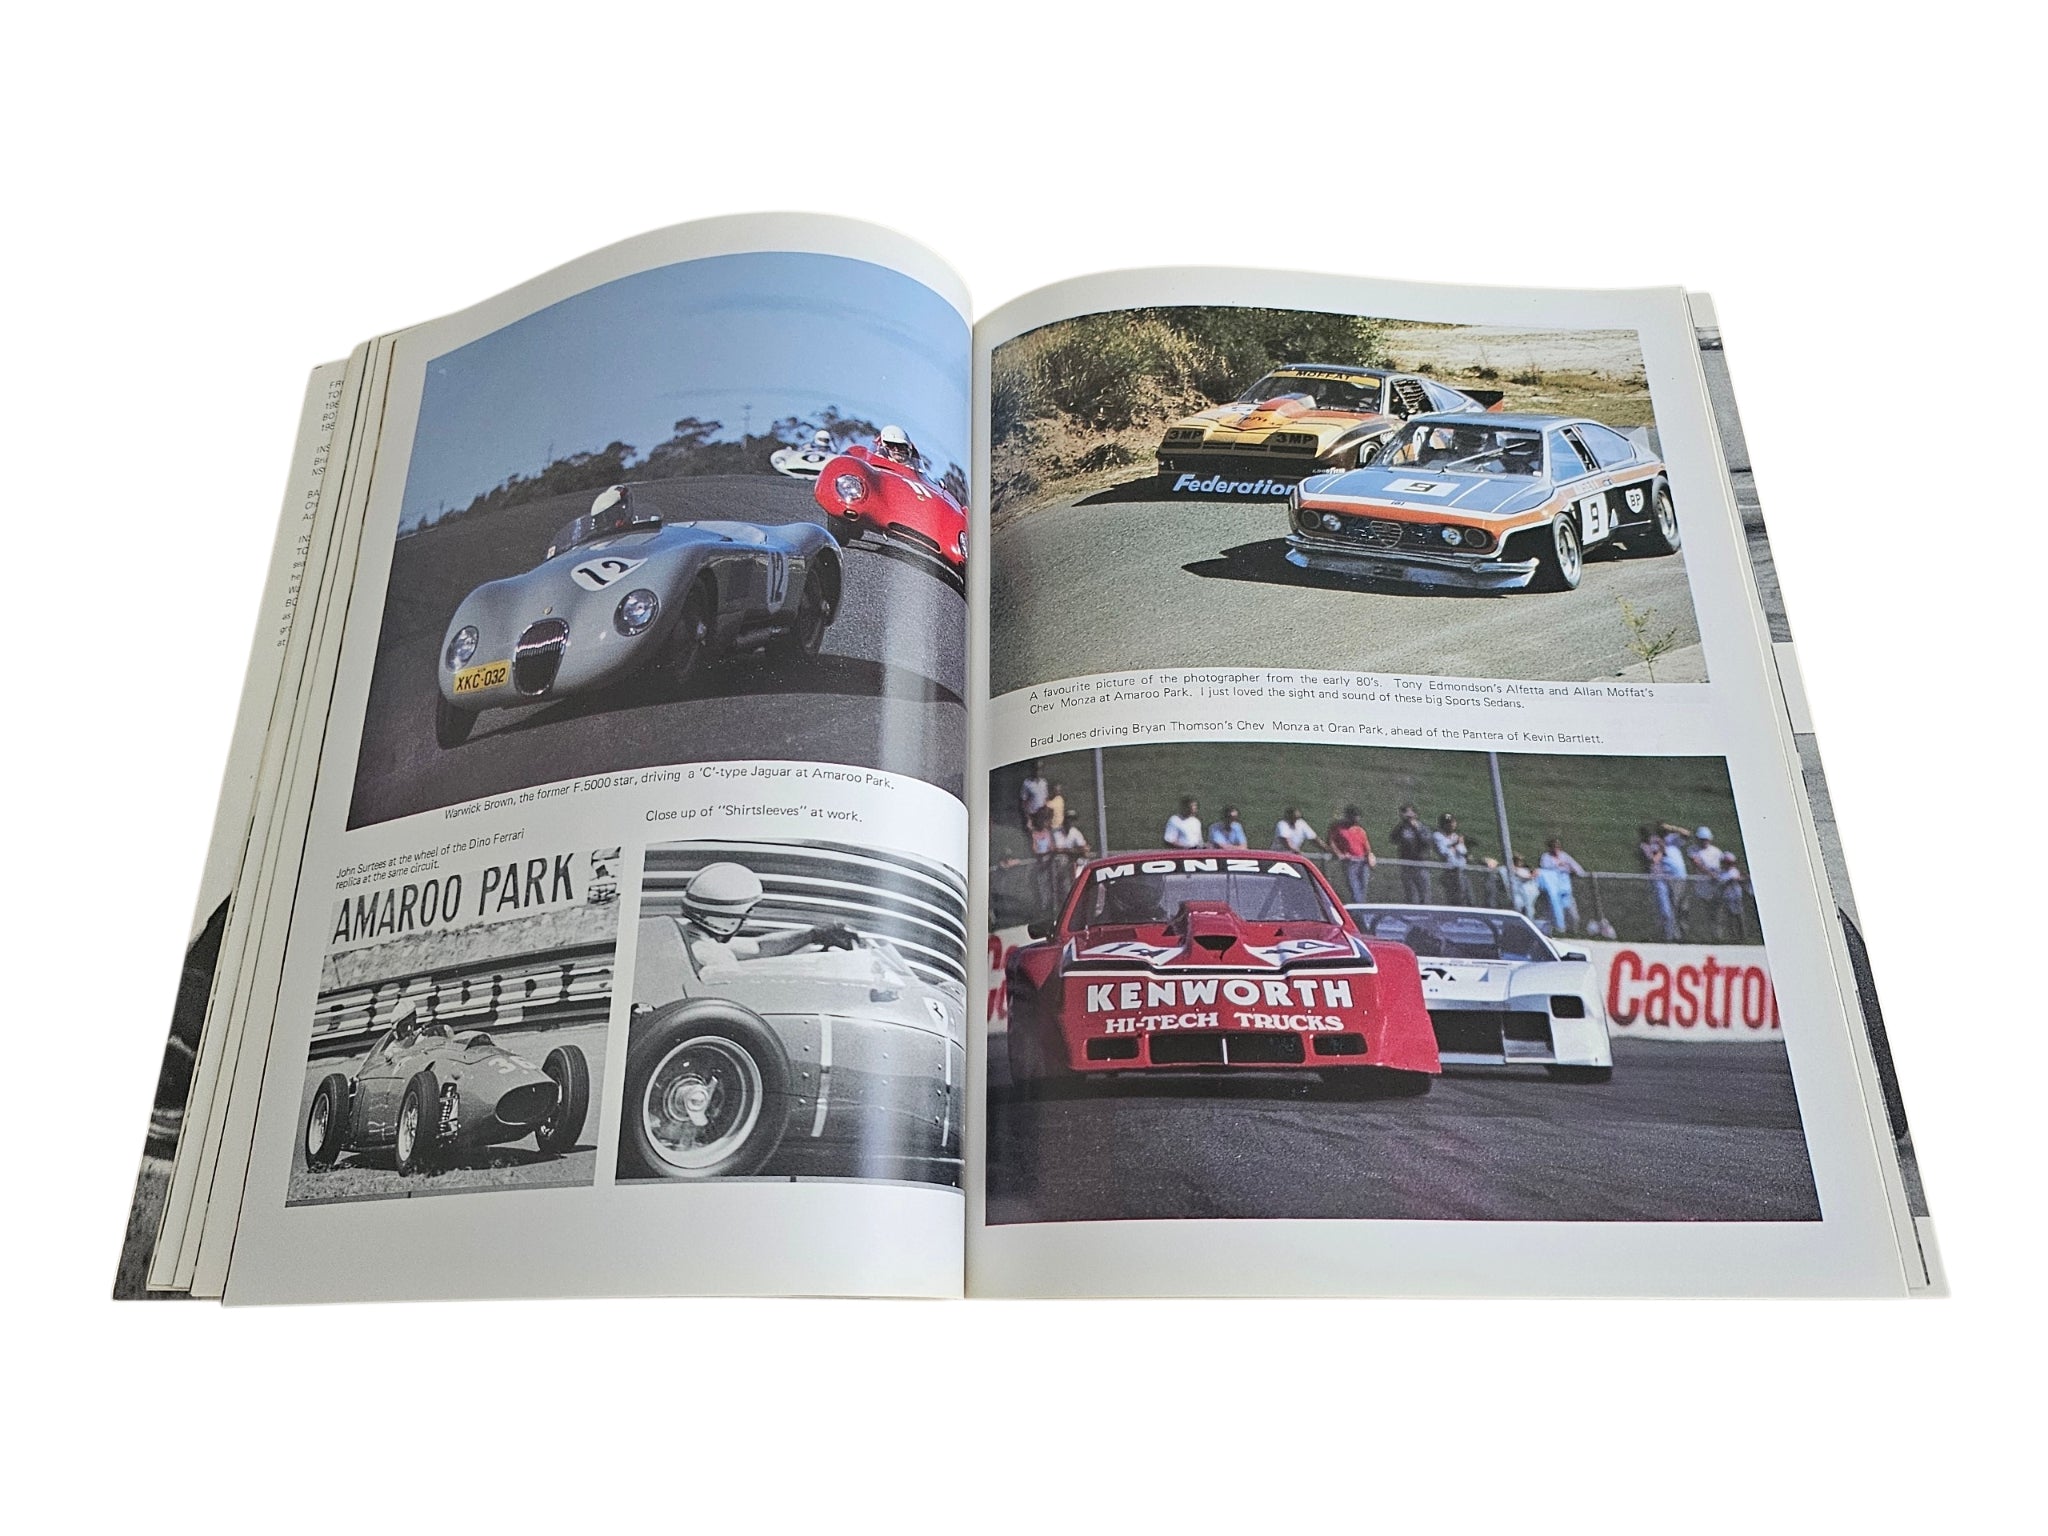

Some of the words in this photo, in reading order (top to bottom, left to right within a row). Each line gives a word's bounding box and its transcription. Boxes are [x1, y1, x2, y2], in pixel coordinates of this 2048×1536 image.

[1296, 371, 1352, 381] MOFFAT
[1277, 434, 1314, 444] 3MP
[1629, 493, 1641, 507] BP
[1590, 502, 1600, 535] 9
[1029, 691, 1038, 701] A
[1043, 682, 1091, 698] favourite
[1096, 677, 1136, 690] picture
[1141, 674, 1153, 685] of
[1160, 675, 1178, 684] the
[1183, 673, 1260, 684] photographer
[1266, 673, 1294, 683] from
[1300, 675, 1318, 684] the
[1323, 676, 1350, 687] early
[1356, 677, 1383, 688] 80's.
[1393, 678, 1422, 691] Tony
[1430, 681, 1502, 693] Edmondson's
[1506, 684, 1544, 695] Alfetta
[1549, 687, 1568, 696] and
[1573, 687, 1602, 697] Allan
[1607, 687, 1654, 698] Moffat's
[1030, 702, 1054, 714] Chev
[1060, 696, 1096, 708] Monza
[1100, 694, 1110, 702] at
[1114, 691, 1160, 701] Amaroo
[1163, 688, 1193, 697] Park.
[1208, 687, 1229, 698] just
[1233, 687, 1263, 696] loved
[1268, 688, 1285, 697] the
[1288, 688, 1315, 700] sight
[1319, 690, 1339, 699] and
[1342, 692, 1375, 701] sound
[1379, 693, 1391, 702] of
[1394, 693, 1422, 704] these
[1425, 695, 1443, 706] big
[1445, 696, 1481, 707] Sports
[1483, 697, 1525, 709] Sedans.
[1030, 734, 1054, 748] Brad
[1056, 730, 1086, 743] Jones
[1090, 725, 1128, 738] driving
[1132, 723, 1165, 734] Bryan
[1170, 720, 1233, 731] Thomson's
[1236, 720, 1265, 731] Chev
[1272, 721, 1310, 731] Monza
[1313, 722, 1324, 731] at
[1328, 723, 1355, 734] Oran
[1359, 724, 1388, 736] Park,
[1390, 726, 1422, 737] ahead
[1426, 728, 1438, 737] of
[1442, 729, 1459, 738] the
[1462, 729, 1503, 740] Pantera
[1507, 732, 1519, 741] of
[1523, 732, 1554, 742] Kevin
[1558, 733, 1604, 744] Bartlett.
[445, 802, 481, 819] Warwick
[484, 797, 517, 811] Brown,
[519, 792, 534, 803] the
[537, 786, 571, 800] former
[573, 776, 611, 793] F.5000
[613, 775, 638, 787] star,
[641, 770, 681, 783] driving
[688, 771, 695, 779] a
[751, 766, 791, 779] Jaguar
[796, 768, 808, 778] at
[812, 768, 862, 783] Amaroo
[866, 774, 895, 790] Park.
[645, 810, 677, 822] Close
[681, 808, 696, 819] up
[700, 806, 714, 817] of
[718, 804, 807, 816] "Shirtsleeves"
[810, 808, 823, 818] at
[827, 810, 863, 822] work.
[336, 866, 356, 879] John
[357, 861, 387, 874] Surtees
[388, 858, 397, 866] at
[399, 853, 412, 864] the
[414, 847, 438, 861] wheel
[441, 844, 451, 856] of
[453, 842, 467, 853] the
[469, 836, 491, 850] Dino
[493, 828, 525, 844] Ferrari
[335, 876, 361, 889] replica
[363, 873, 371, 884] at
[373, 870, 386, 881] the
[388, 867, 409, 879] same
[410, 860, 440, 874] circuit.
[1096, 859, 1302, 883] MONZA
[331, 873, 462, 944] AMAROO
[478, 852, 575, 916] PARK
[1087, 979, 1354, 1013] KENWORTH
[1105, 1013, 1219, 1034] HI-TECH
[1233, 1012, 1344, 1031] TRUCKS
